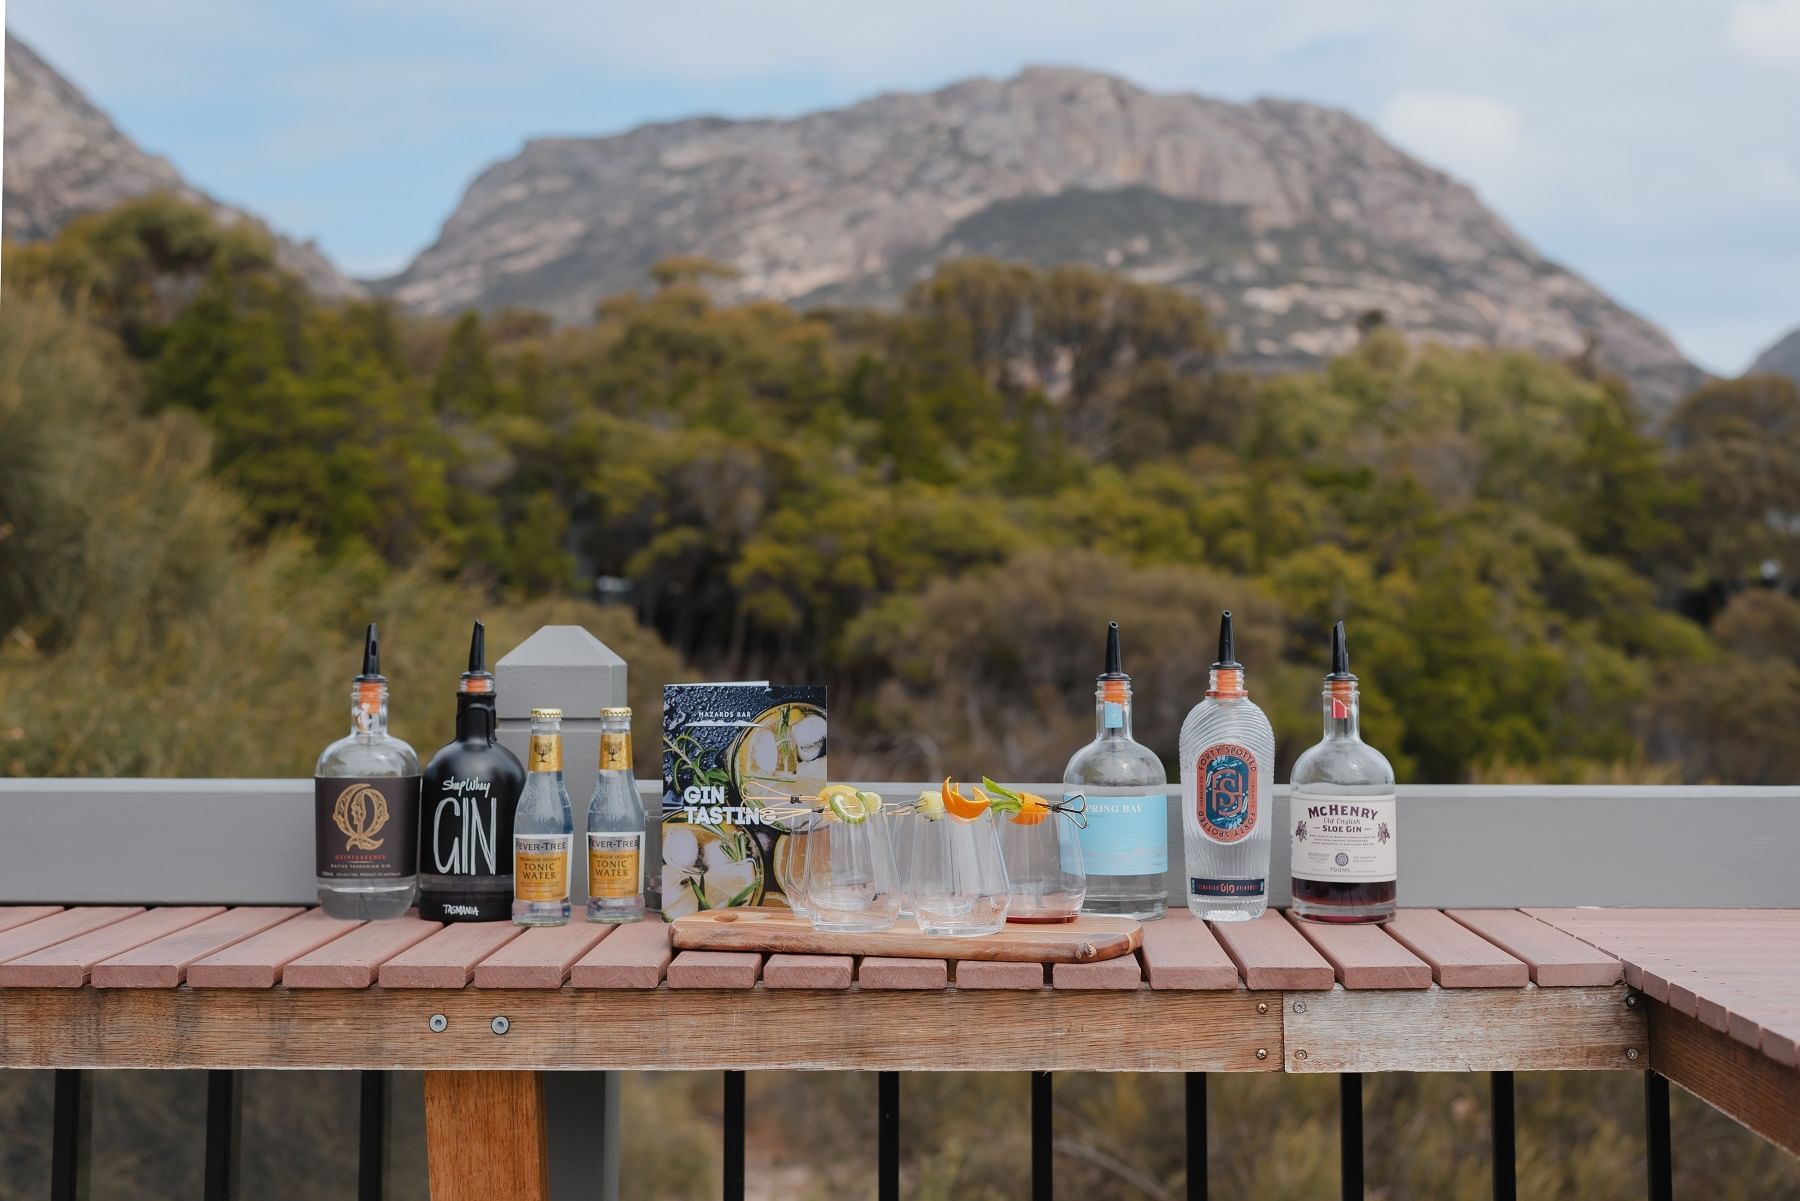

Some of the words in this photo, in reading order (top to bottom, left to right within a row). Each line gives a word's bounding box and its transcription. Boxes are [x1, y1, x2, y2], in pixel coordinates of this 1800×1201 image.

[1199, 747, 1220, 770] FORTY
[1225, 746, 1257, 772] SPOTTED
[683, 785, 725, 804] GIN
[1081, 804, 1119, 814] PRING
[1122, 804, 1143, 814] BAY
[683, 806, 777, 825] TASTING
[433, 797, 497, 876] GIN
[588, 839, 640, 849] EVER-TREE
[524, 863, 556, 871] TONIC
[597, 860, 628, 868] TONIC
[523, 871, 557, 880] WATER
[595, 868, 629, 877] WATER
[442, 903, 479, 916] TASMANIA
